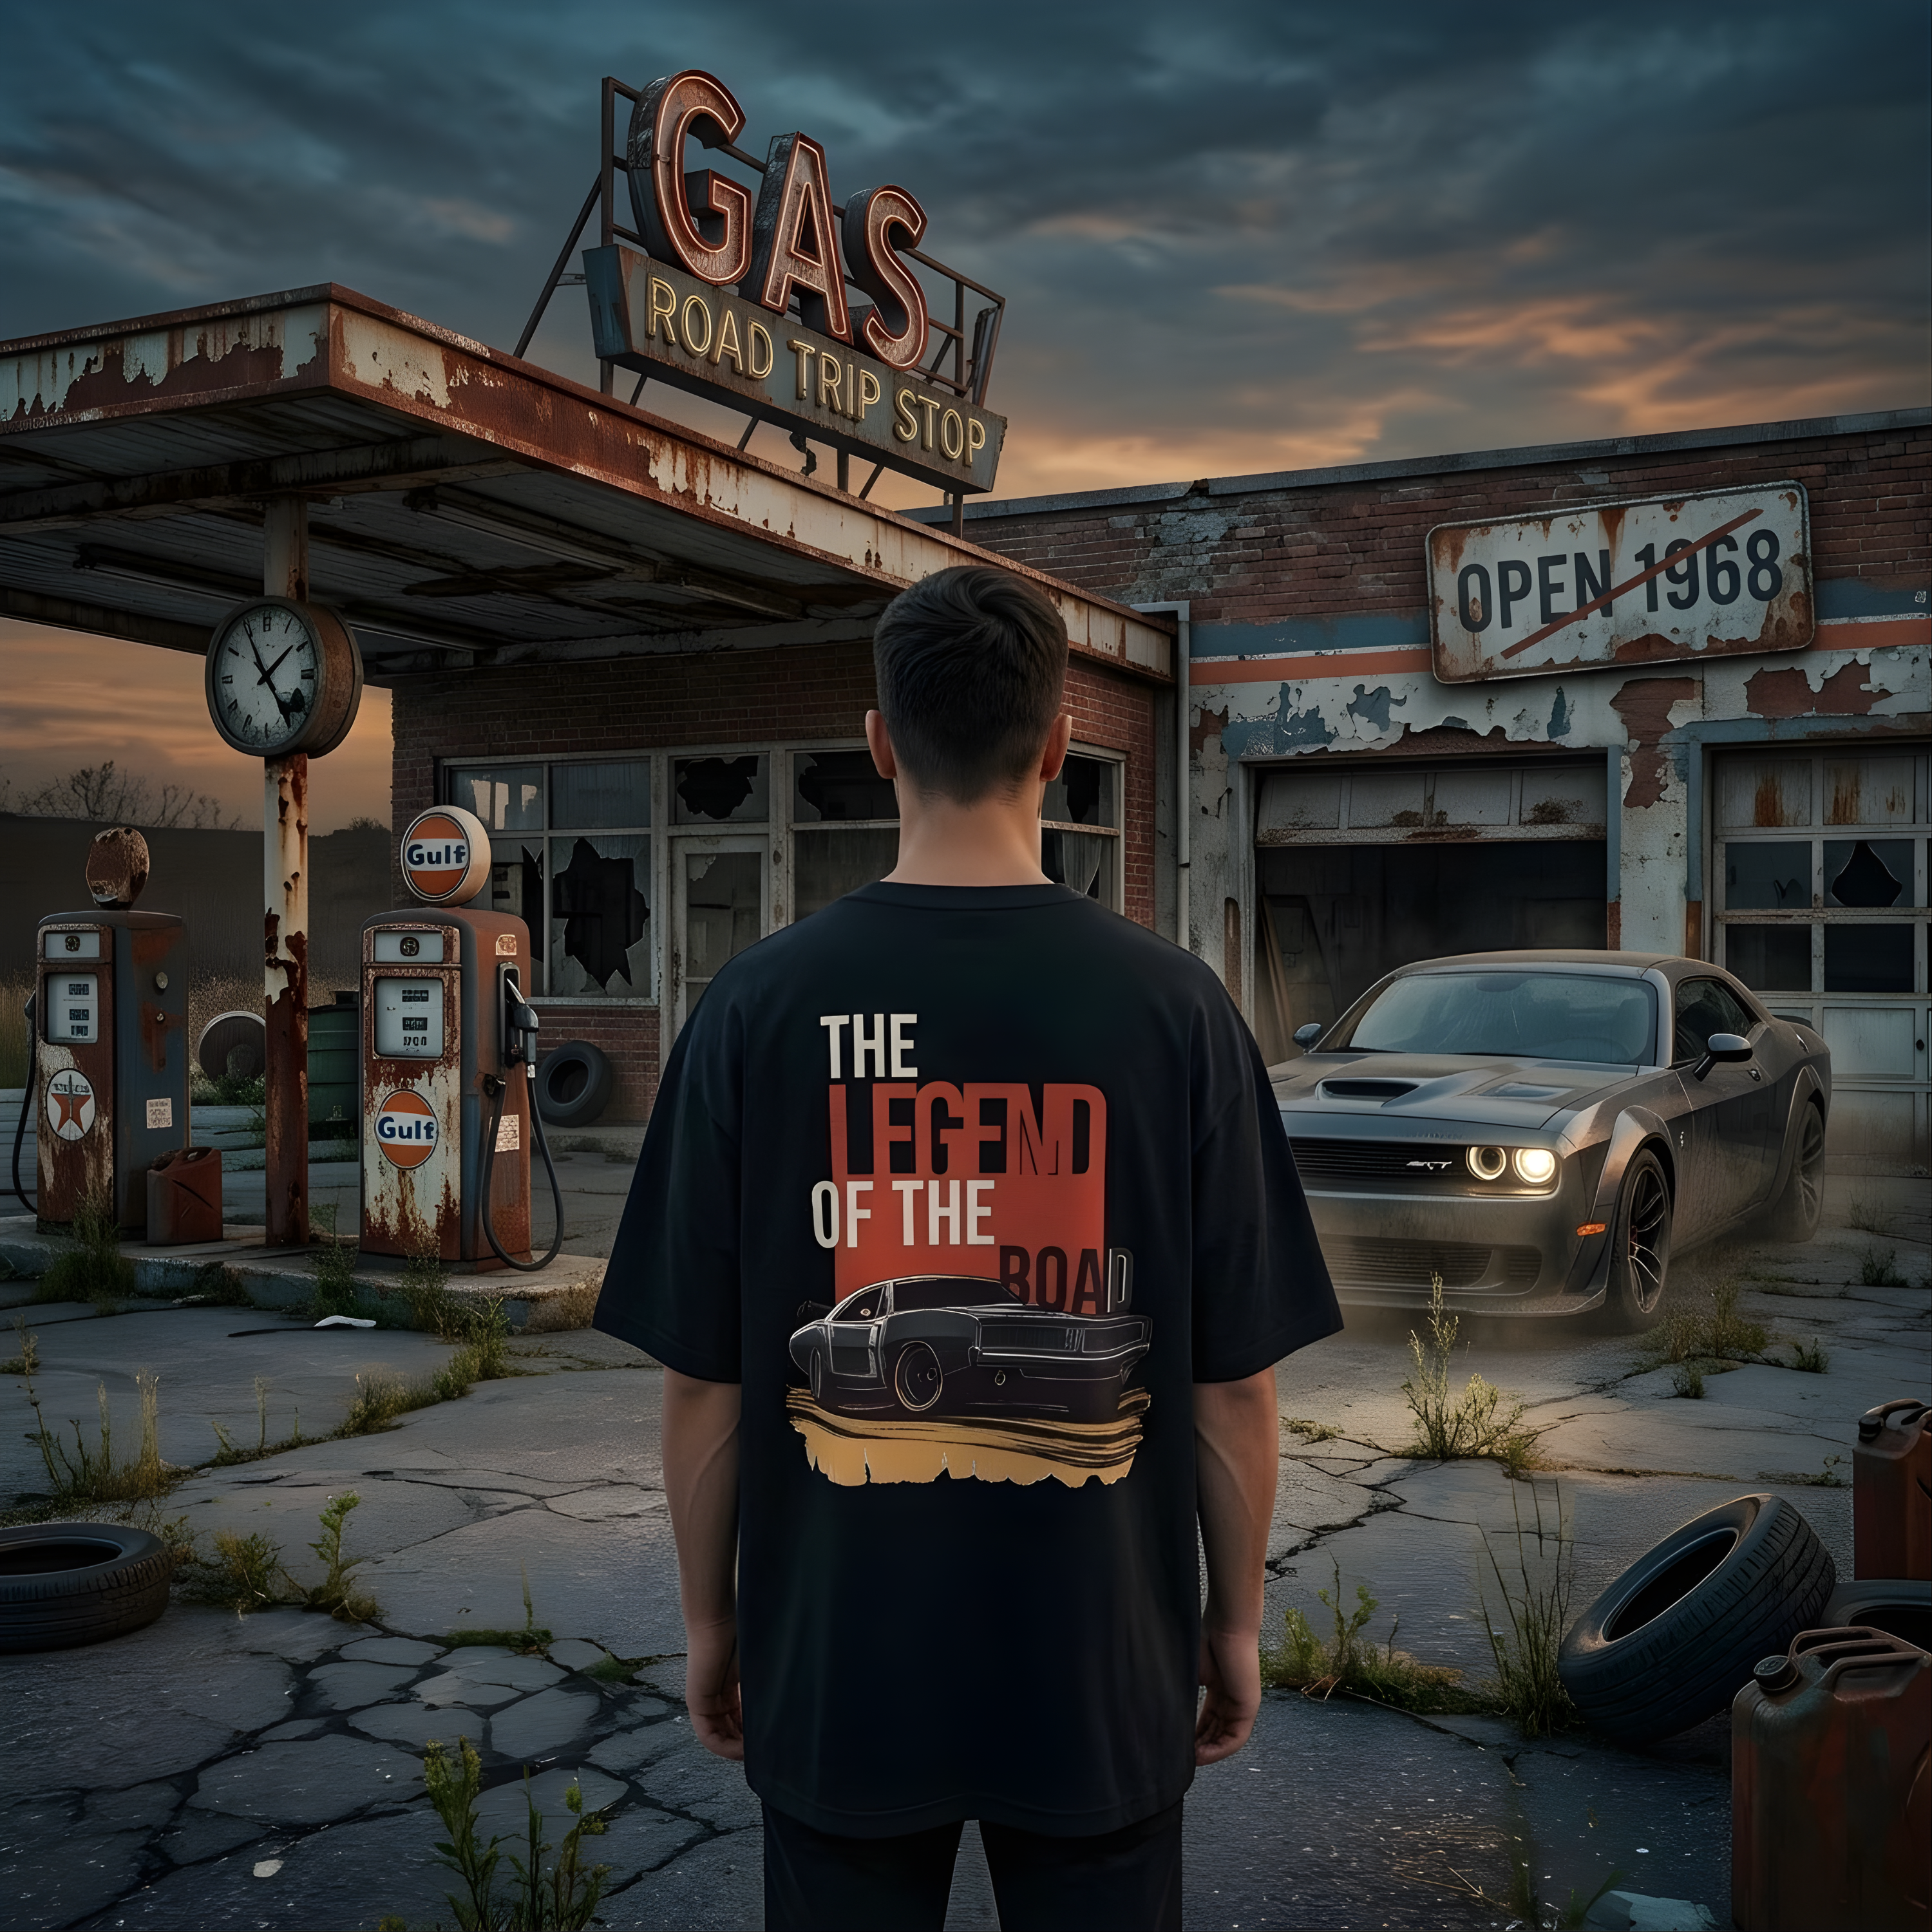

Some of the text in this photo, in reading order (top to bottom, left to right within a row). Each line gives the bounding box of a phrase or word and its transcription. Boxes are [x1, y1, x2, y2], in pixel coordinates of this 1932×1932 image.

[629, 70, 928, 371] GAS
[646, 272, 986, 467] ROAD TRIP STOP
[1457, 529, 1783, 633] OPEN 1968
[406, 842, 467, 866] Gulf
[820, 1013, 918, 1079] THE
[377, 1115, 435, 1141] Gulf
[829, 1081, 1107, 1175] LEGEND
[811, 1180, 995, 1248] OF THE
